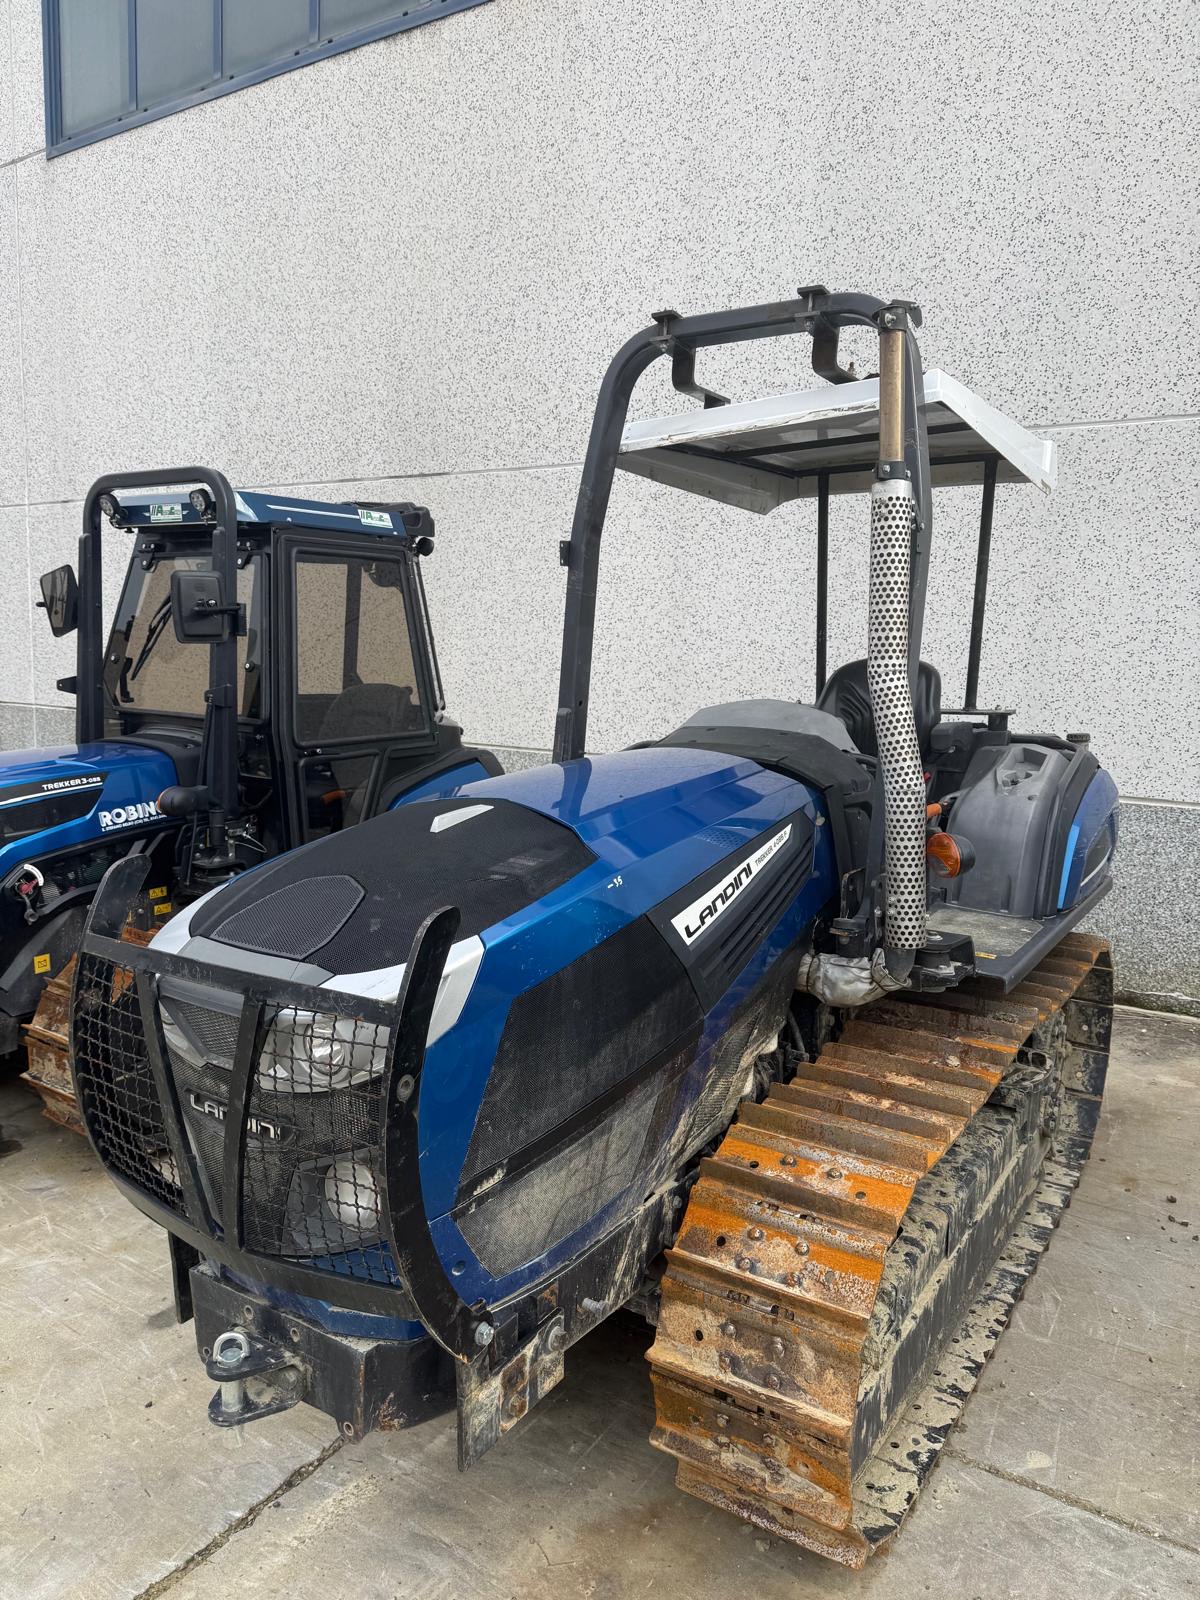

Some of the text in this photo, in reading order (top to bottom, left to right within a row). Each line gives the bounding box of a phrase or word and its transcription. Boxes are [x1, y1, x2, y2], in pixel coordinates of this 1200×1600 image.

[42, 779, 81, 791] TREKKER
[99, 801, 161, 827] ROBIN
[684, 863, 753, 939] LANDINI
[754, 845, 774, 867] TREKKER
